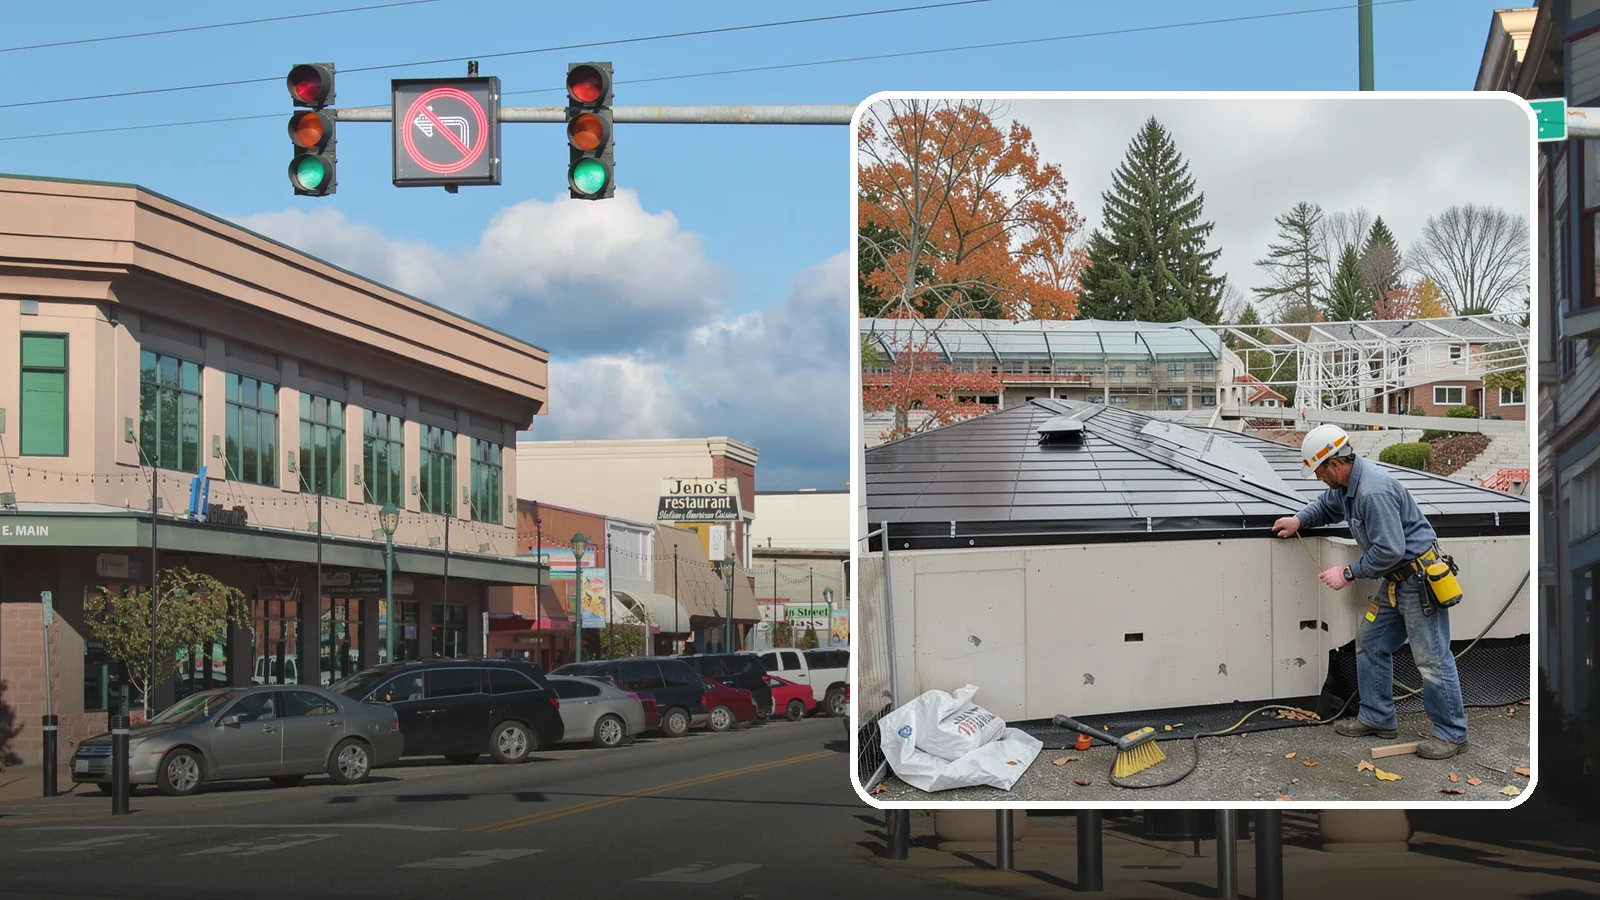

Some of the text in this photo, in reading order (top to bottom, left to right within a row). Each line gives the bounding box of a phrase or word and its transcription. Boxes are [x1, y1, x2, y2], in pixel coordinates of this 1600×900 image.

[669, 480, 727, 494] Jeno's
[665, 497, 730, 508] restaurant
[659, 510, 682, 519] Italian
[686, 510, 714, 519] American
[715, 509, 738, 519] Cuisine
[2, 525, 49, 536] E. MAIN
[797, 607, 828, 616] Street
